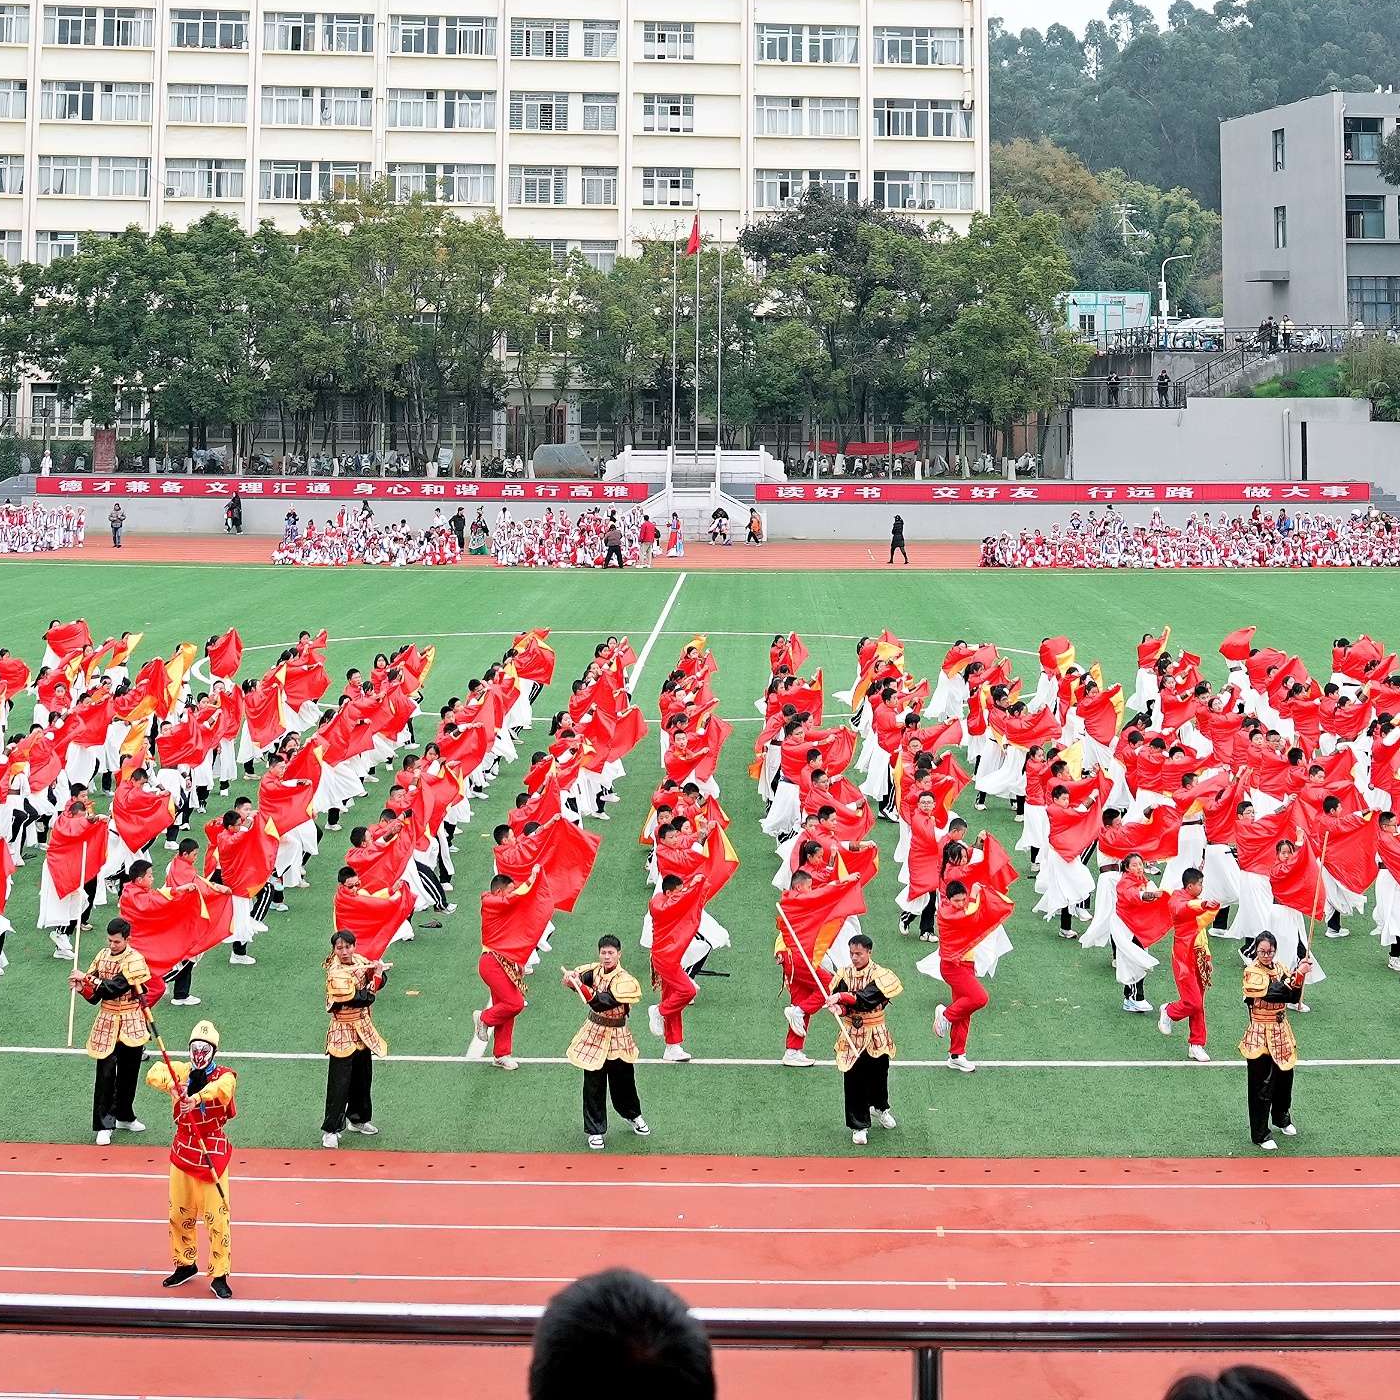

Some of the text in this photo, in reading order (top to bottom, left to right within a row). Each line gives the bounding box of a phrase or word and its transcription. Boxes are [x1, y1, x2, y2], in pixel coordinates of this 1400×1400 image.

[58, 480, 630, 497] 德才兼备 文理汇通 身心和谐 品行高雅
[775, 486, 1351, 499] 读好书 交好友 行远路 做大事
